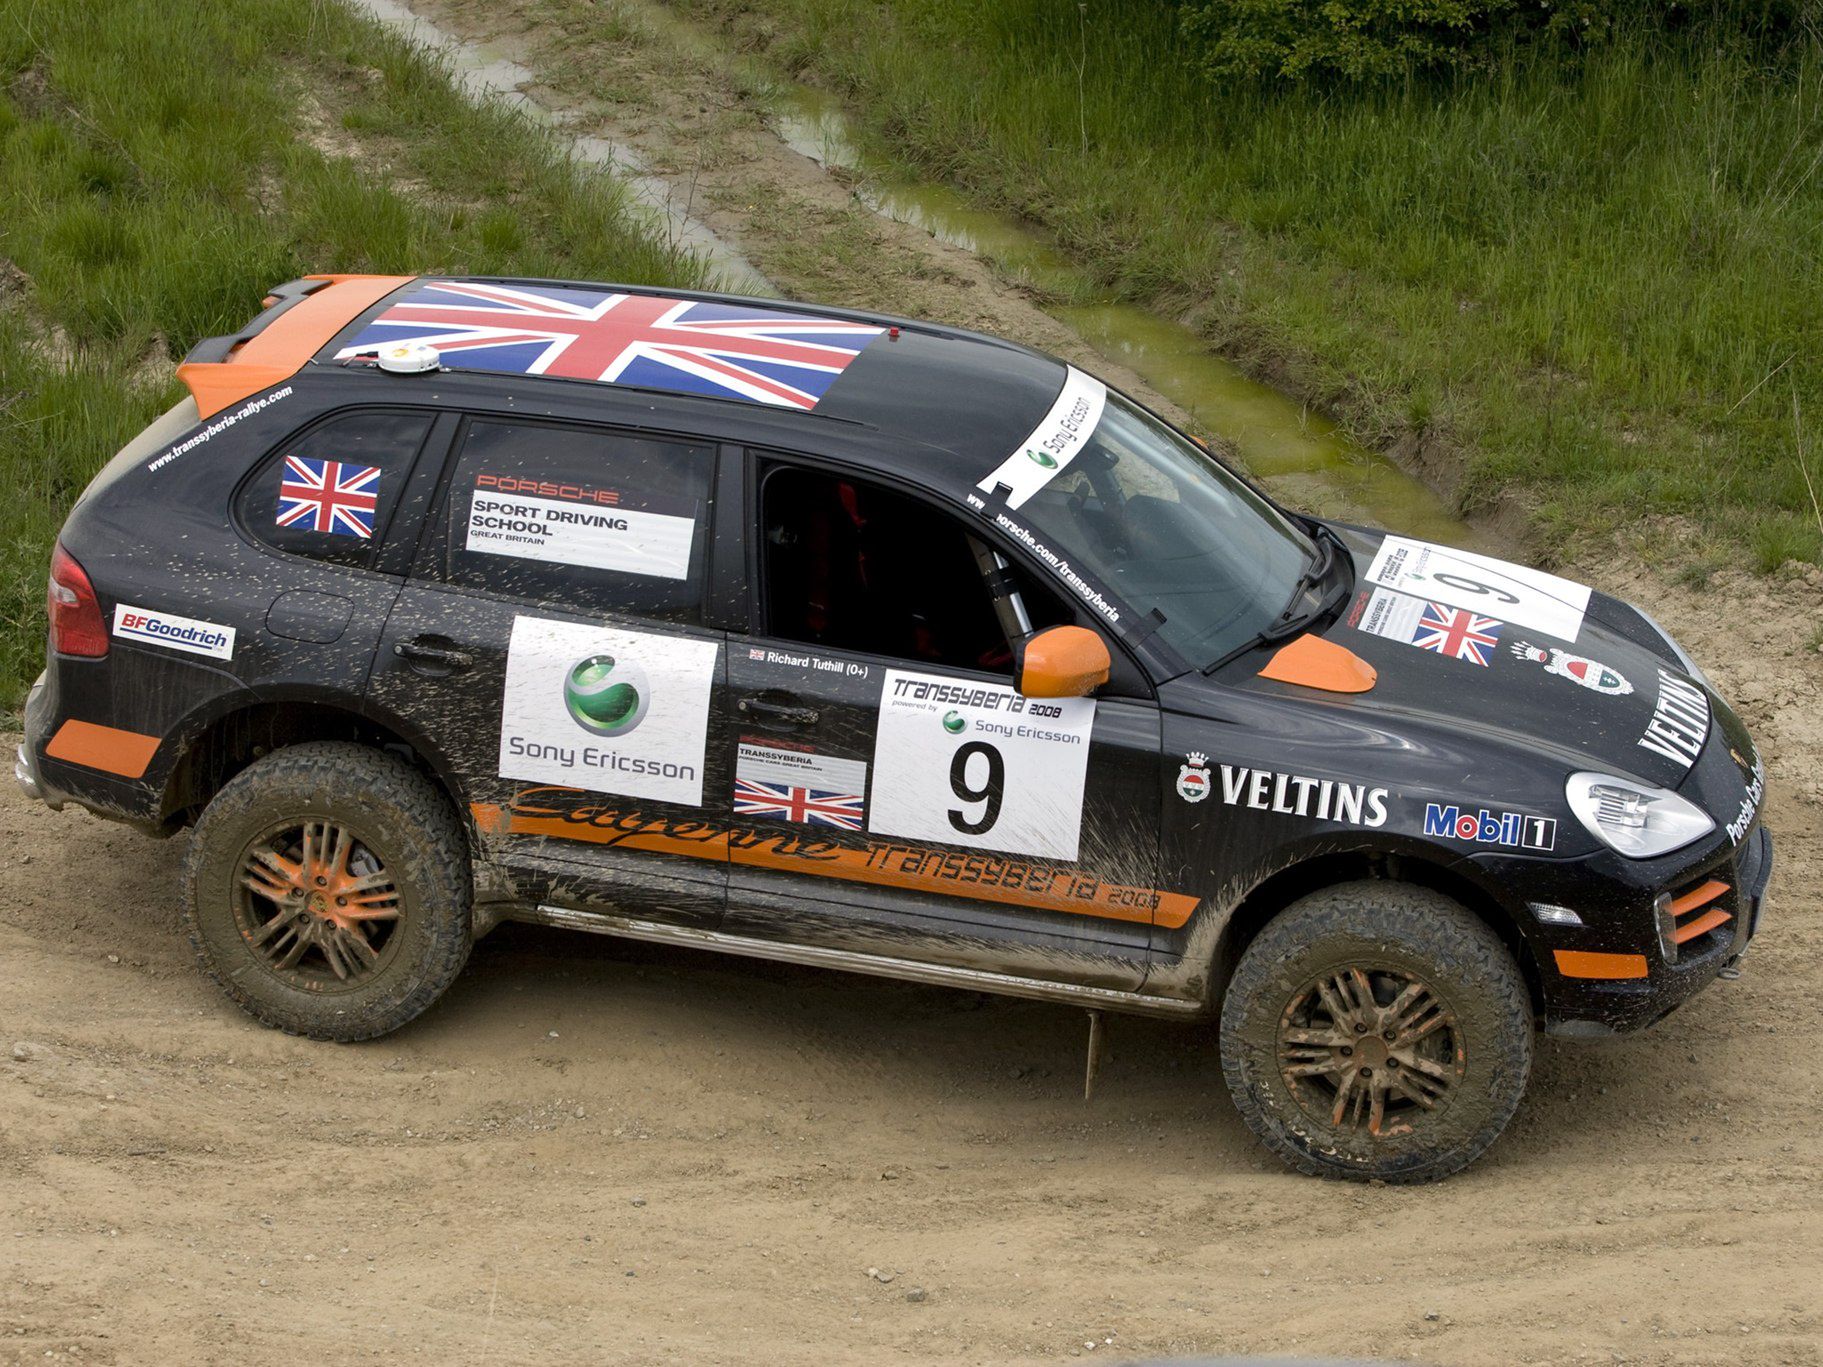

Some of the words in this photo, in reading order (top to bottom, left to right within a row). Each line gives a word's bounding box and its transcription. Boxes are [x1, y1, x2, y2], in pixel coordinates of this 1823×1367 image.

[148, 385, 293, 472] www.transsyberia-rallye.com
[1060, 397, 1091, 432] Ericsson
[1043, 428, 1078, 454] Sony
[477, 475, 619, 504] PORSCHE
[471, 515, 553, 536] SCHOOL
[474, 500, 541, 519] SPORT
[546, 509, 628, 531] DRIVING
[470, 530, 503, 540] GREAT
[505, 534, 545, 545] BRITAIN
[121, 613, 227, 647] BFGoodrich
[767, 651, 809, 668] Richard
[812, 658, 844, 673] Tuthill
[891, 700, 927, 710] powered
[928, 703, 938, 713] by
[1028, 703, 1063, 718] 2008
[1637, 669, 1708, 768] VELTINS
[975, 719, 1013, 737] Sony
[1016, 727, 1081, 744] Ericsson
[509, 737, 575, 768] Sony
[583, 748, 695, 781] Ericsson
[947, 741, 1005, 836] 9
[1220, 764, 1388, 827] VELTINS
[508, 787, 840, 861] Cayenne
[1424, 803, 1521, 846] Mobil
[1726, 800, 1757, 846] Porsche
[1107, 887, 1161, 910] 2008
